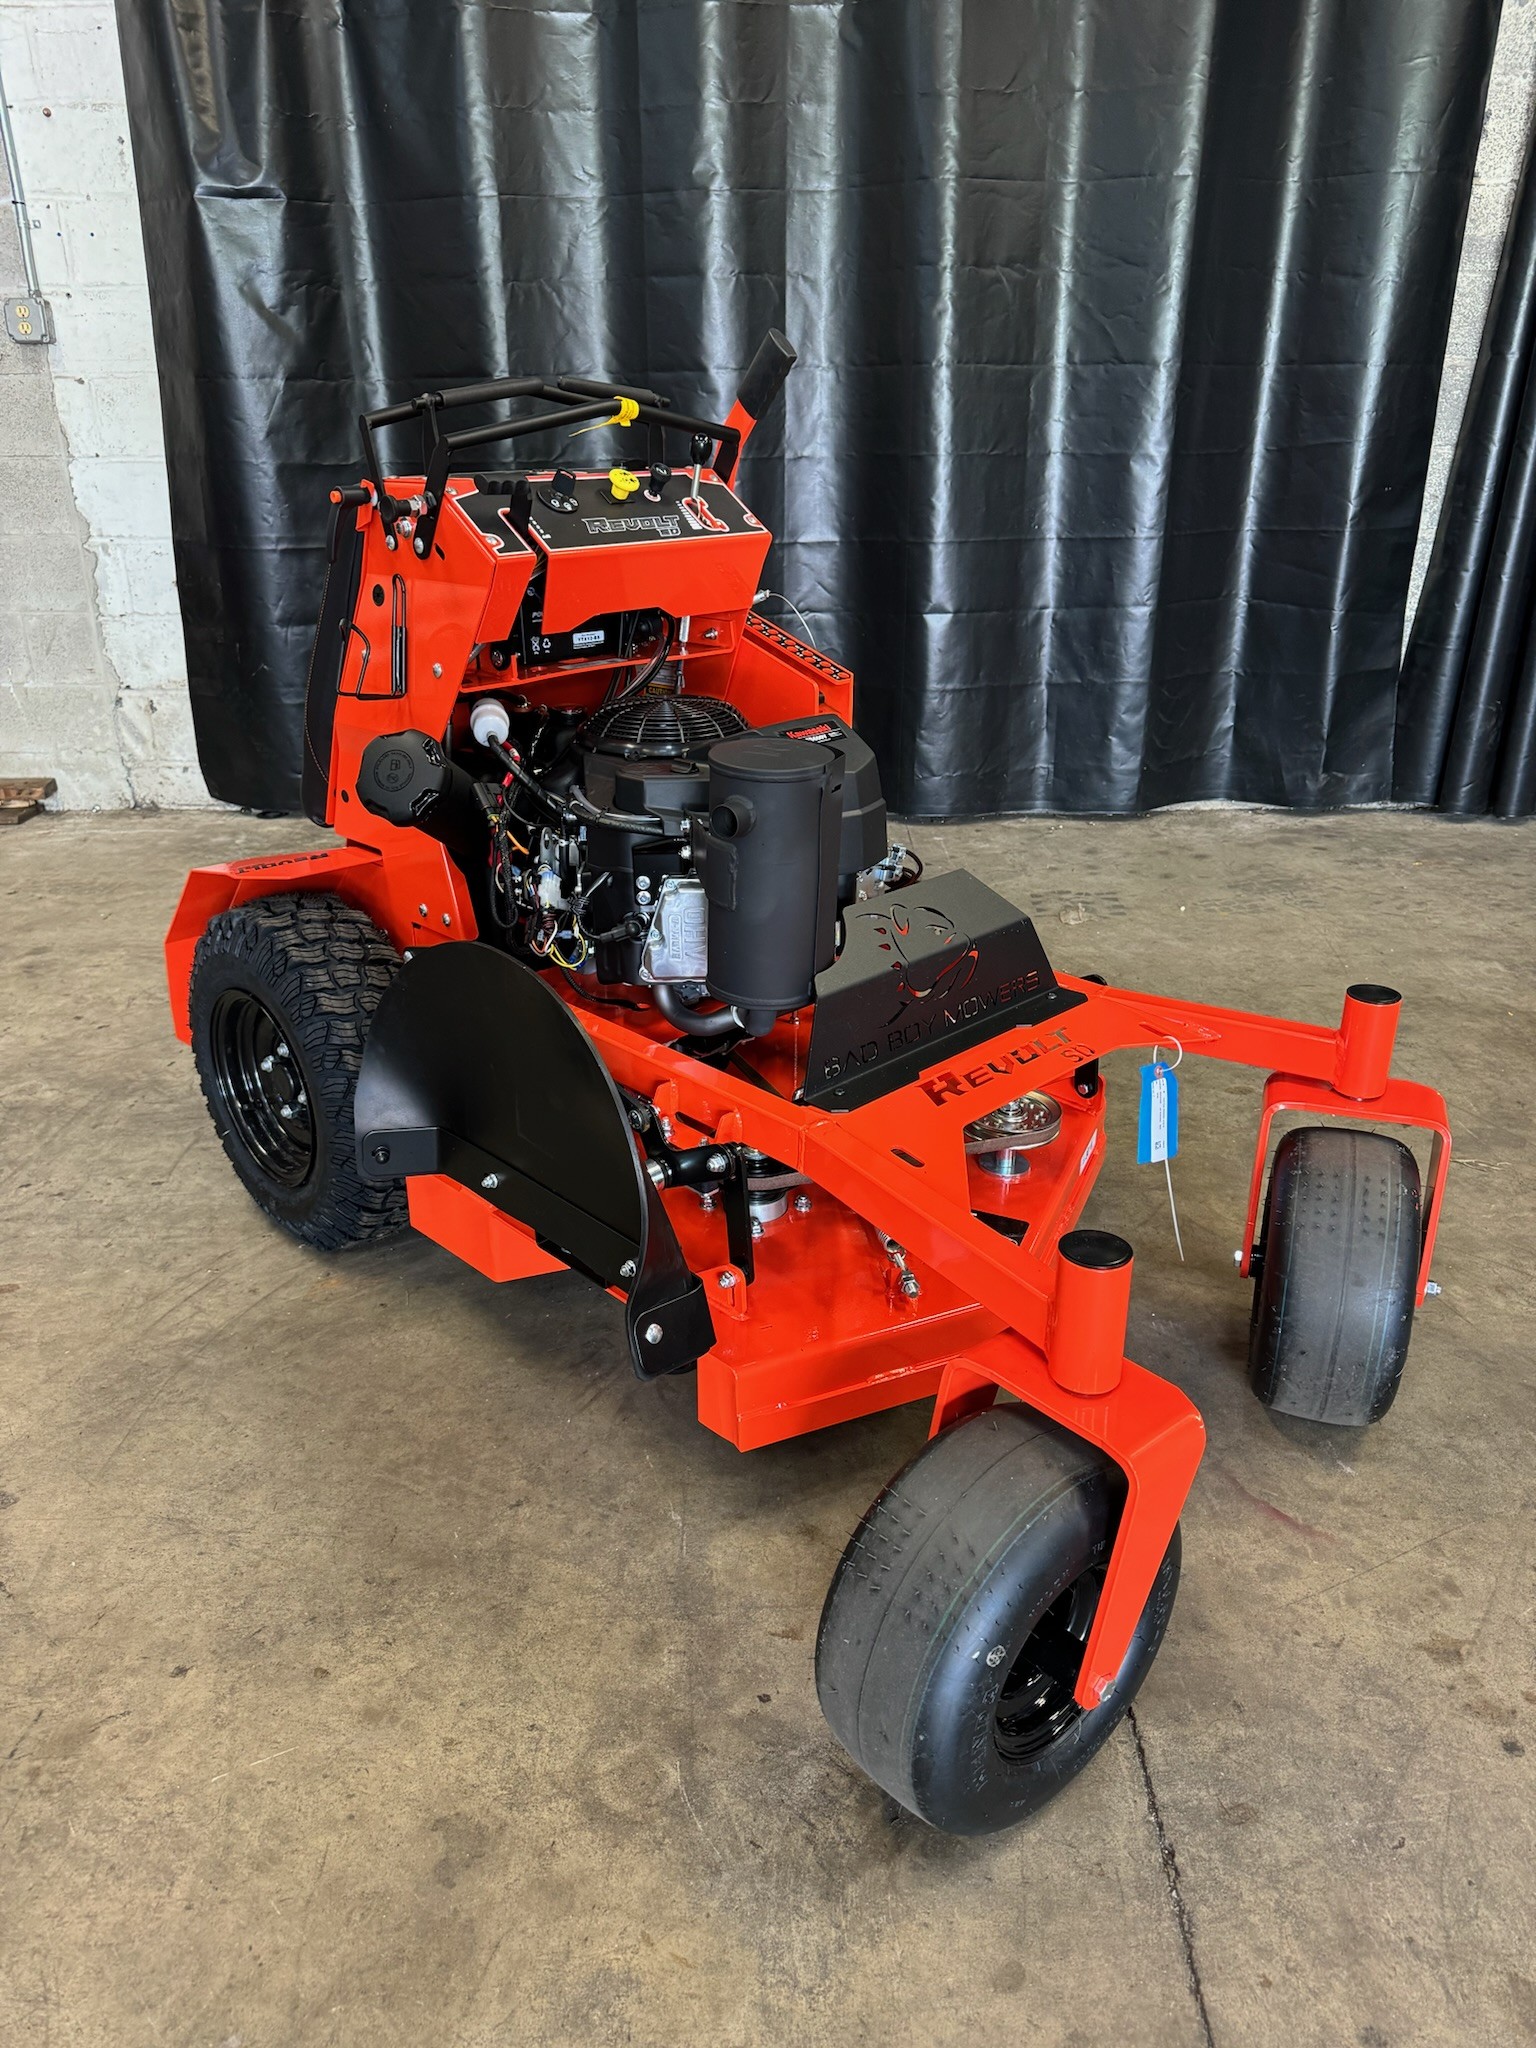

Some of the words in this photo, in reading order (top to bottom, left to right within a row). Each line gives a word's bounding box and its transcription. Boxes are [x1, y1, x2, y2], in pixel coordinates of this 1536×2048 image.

[786, 723, 832, 739] Kawasaki
[823, 1040, 878, 1080] BAD
[887, 1013, 936, 1052] BOY
[943, 969, 1041, 1028] MOWERS
[914, 1026, 1072, 1107] REVOLT
